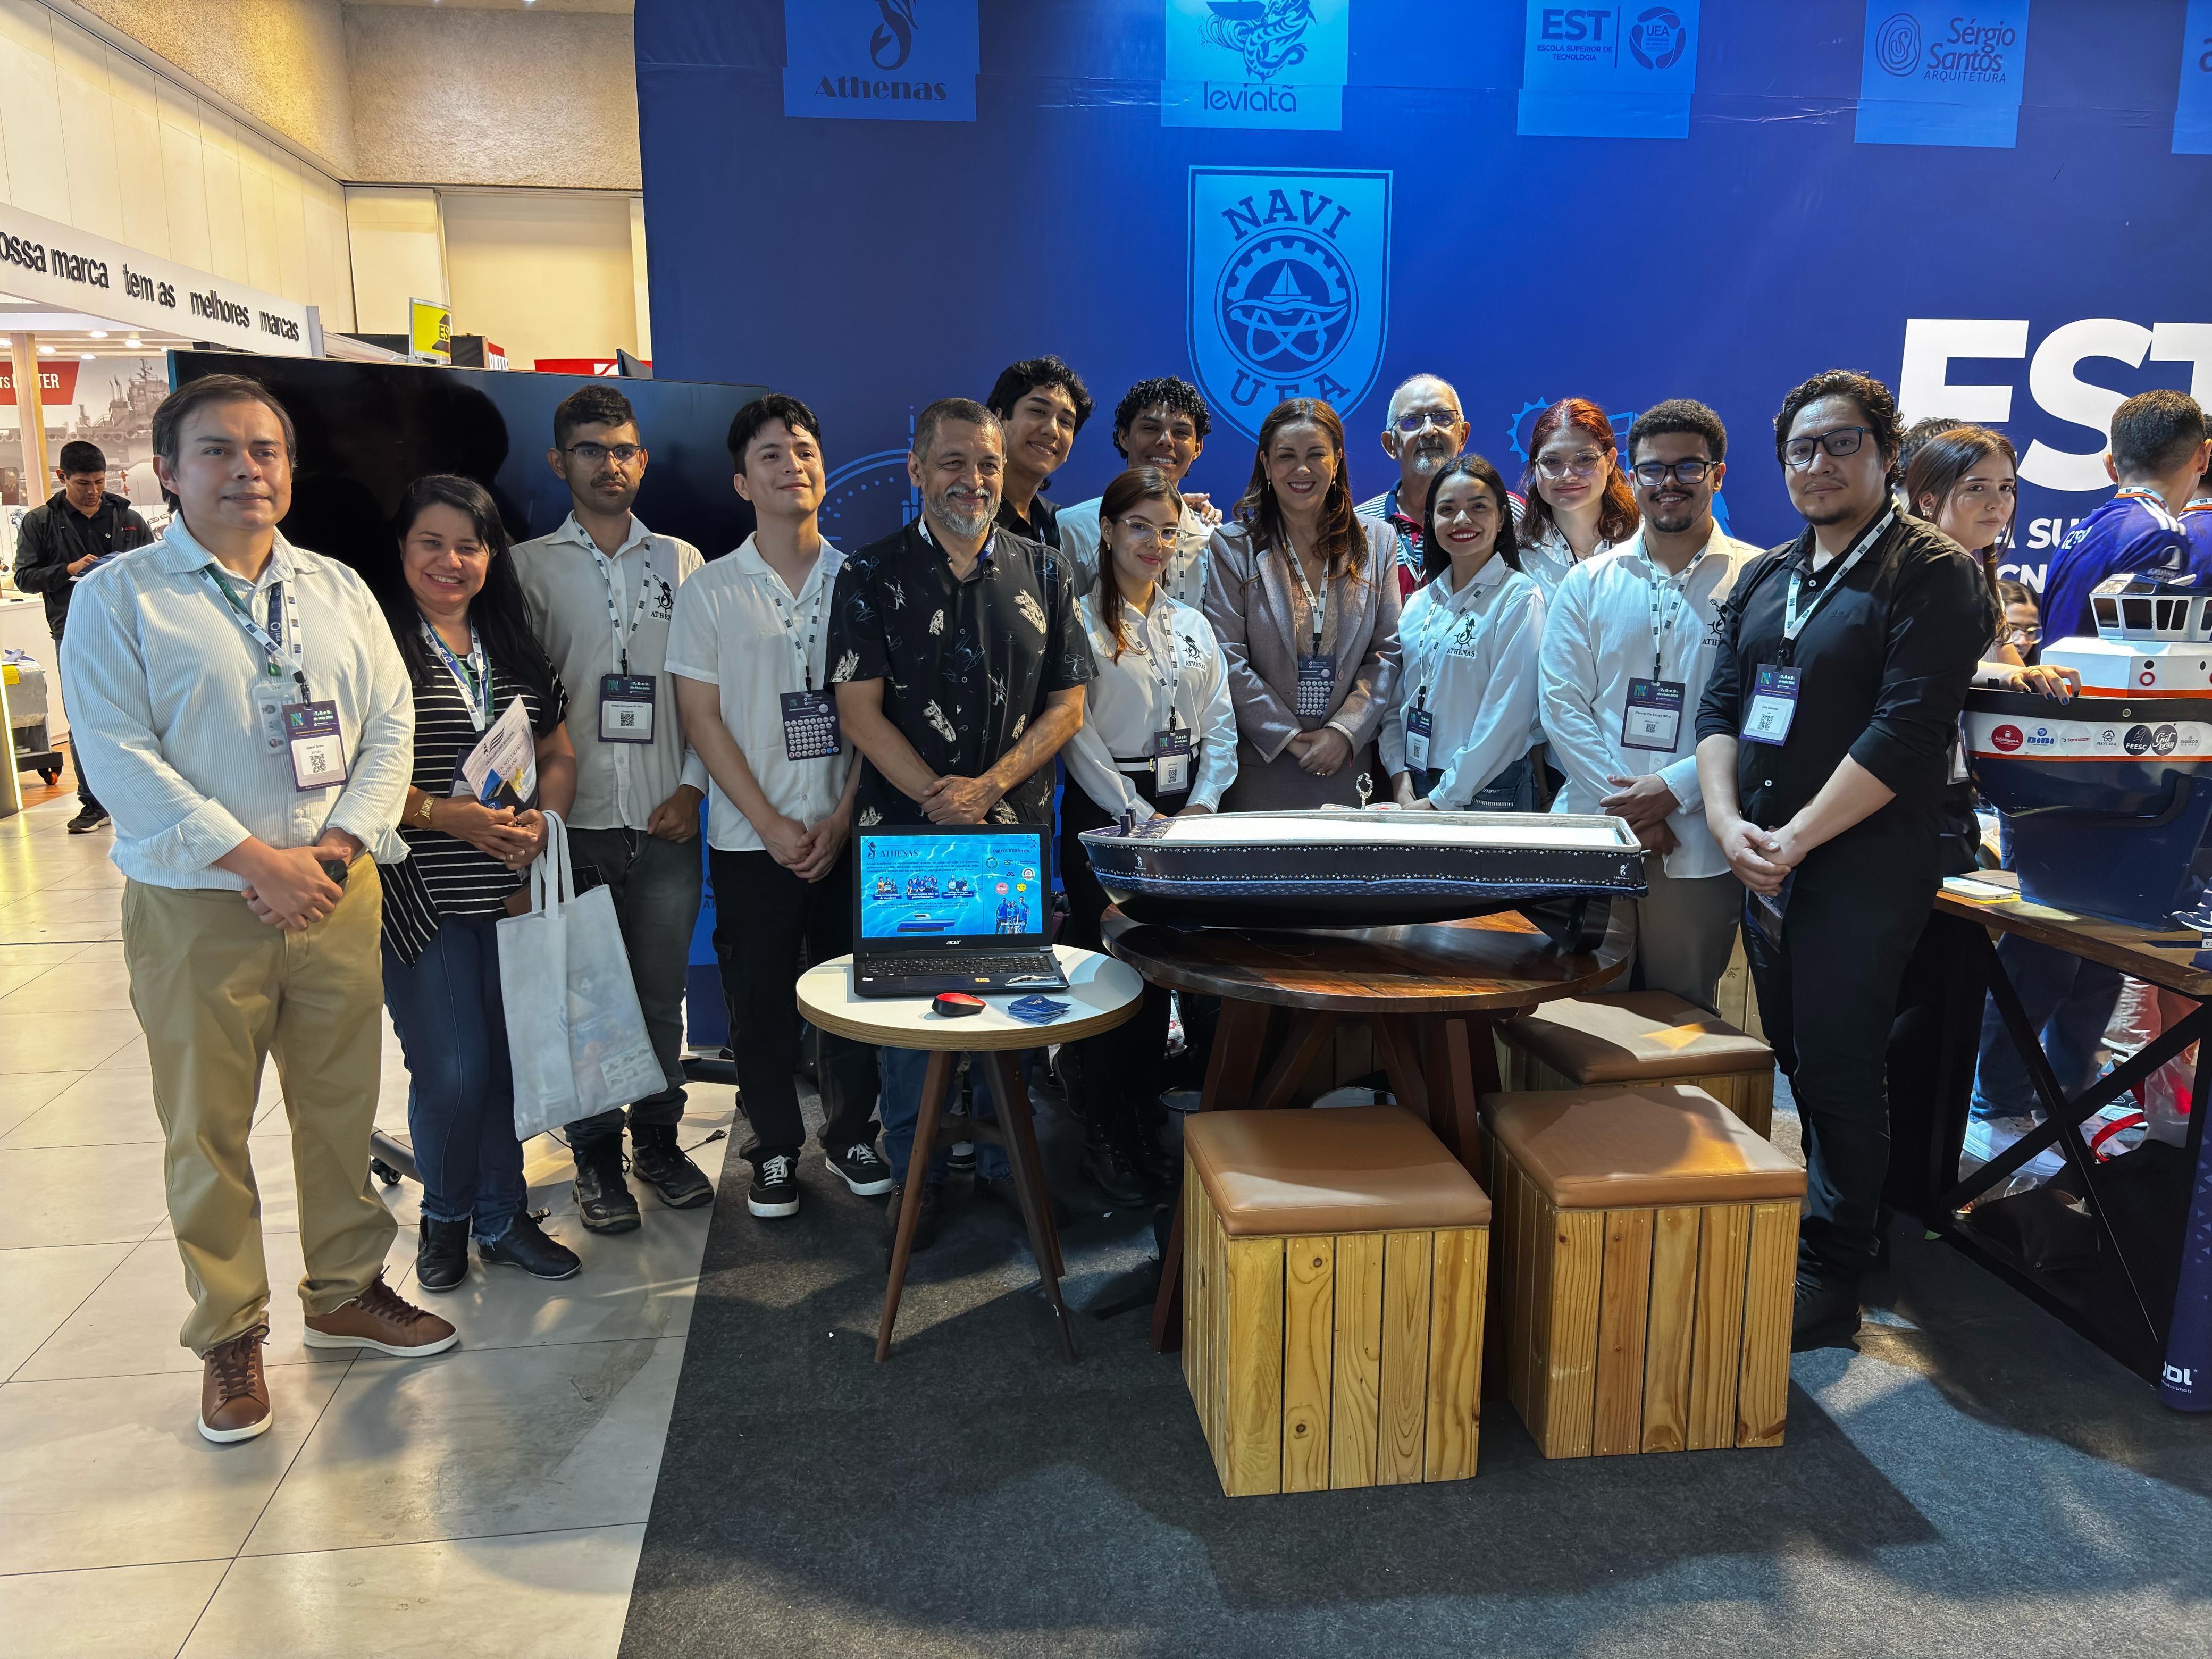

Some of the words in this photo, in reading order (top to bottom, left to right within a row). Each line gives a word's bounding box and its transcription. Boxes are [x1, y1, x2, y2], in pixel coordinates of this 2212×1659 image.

[1541, 9, 1611, 41] EST
[1646, 25, 1670, 37] UEA
[1947, 16, 2016, 54] Sérgio
[1926, 43, 2003, 72] Santos
[1924, 70, 2006, 83] ARQUITETURA
[814, 75, 948, 102] Athenas
[1203, 81, 1297, 112] leviatã
[1221, 189, 1352, 241] NAVI
[51, 248, 110, 288] marca
[123, 263, 155, 302] tem
[158, 281, 176, 308] as
[190, 290, 250, 328] melhores
[259, 310, 299, 342] marcas
[650, 611, 672, 621] ATHEN
[1446, 648, 1475, 657] ATHENAS
[1186, 660, 1206, 671] ATHENAS
[2154, 732, 2176, 745] Gut
[879, 849, 919, 858] ATHENAS
